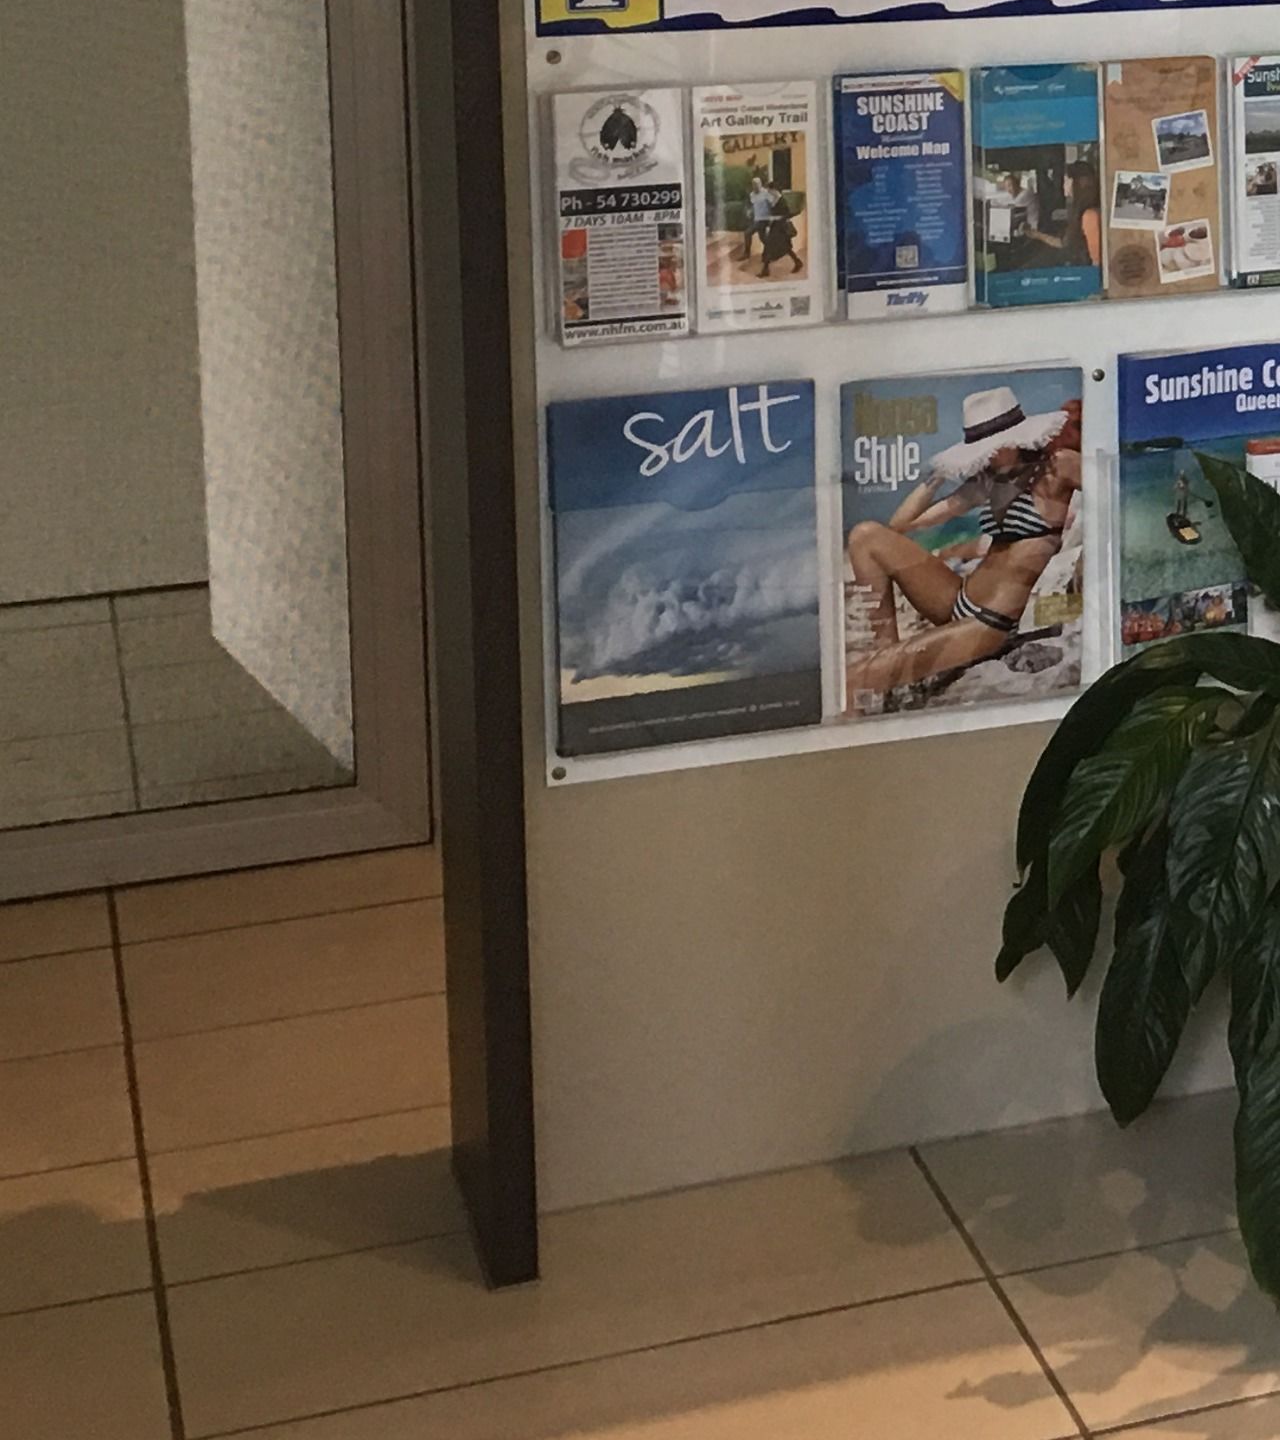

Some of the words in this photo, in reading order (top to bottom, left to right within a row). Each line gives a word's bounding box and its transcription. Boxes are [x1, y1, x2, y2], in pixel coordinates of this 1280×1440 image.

[856, 92, 945, 116] SUNSHINE
[700, 115, 722, 128] Art
[725, 114, 774, 127] Gallery
[778, 111, 808, 123] Trail
[872, 112, 930, 133] COAST
[722, 130, 800, 154] GALLERY
[856, 144, 920, 161] Welcome
[922, 141, 951, 156] Map
[561, 196, 582, 211] Ph
[596, 193, 617, 209] 54
[620, 190, 681, 206] 730299
[565, 218, 573, 228] 7
[574, 215, 606, 227] DAYS
[611, 212, 644, 225] 10AM
[1145, 364, 1254, 405] Sunshine
[623, 385, 800, 477] salt
[854, 433, 921, 491] Style
